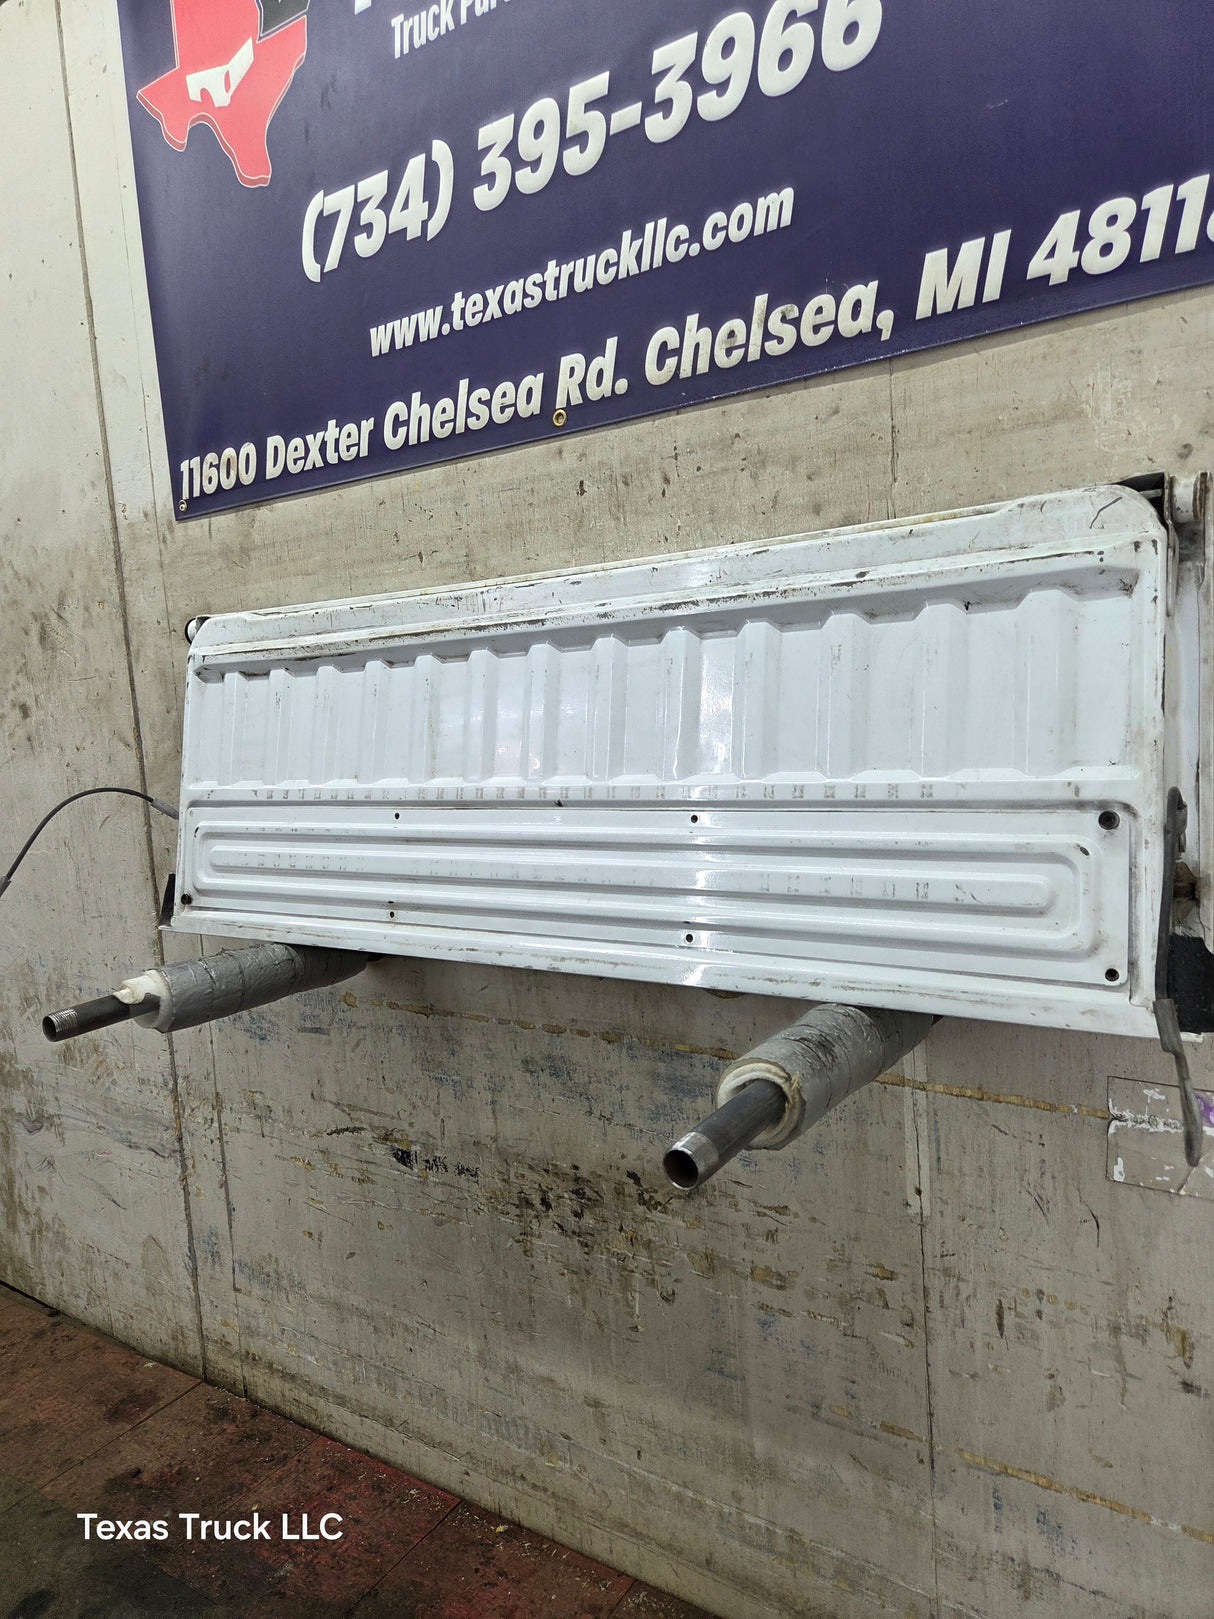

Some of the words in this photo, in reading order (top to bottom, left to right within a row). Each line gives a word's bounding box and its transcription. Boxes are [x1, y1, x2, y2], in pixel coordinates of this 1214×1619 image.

[301, 138, 455, 283] (734)
[472, 0, 884, 212] 395-3966
[390, 0, 456, 60] Truck
[180, 441, 257, 500] 11600
[265, 416, 375, 480] Dexter
[383, 372, 545, 450] Chelsea
[555, 335, 629, 410] Rd.
[644, 279, 895, 386] Chelsea,
[915, 229, 1012, 320] MI
[1026, 173, 1214, 286] 4811
[369, 186, 795, 358] www.texastruckllc.com
